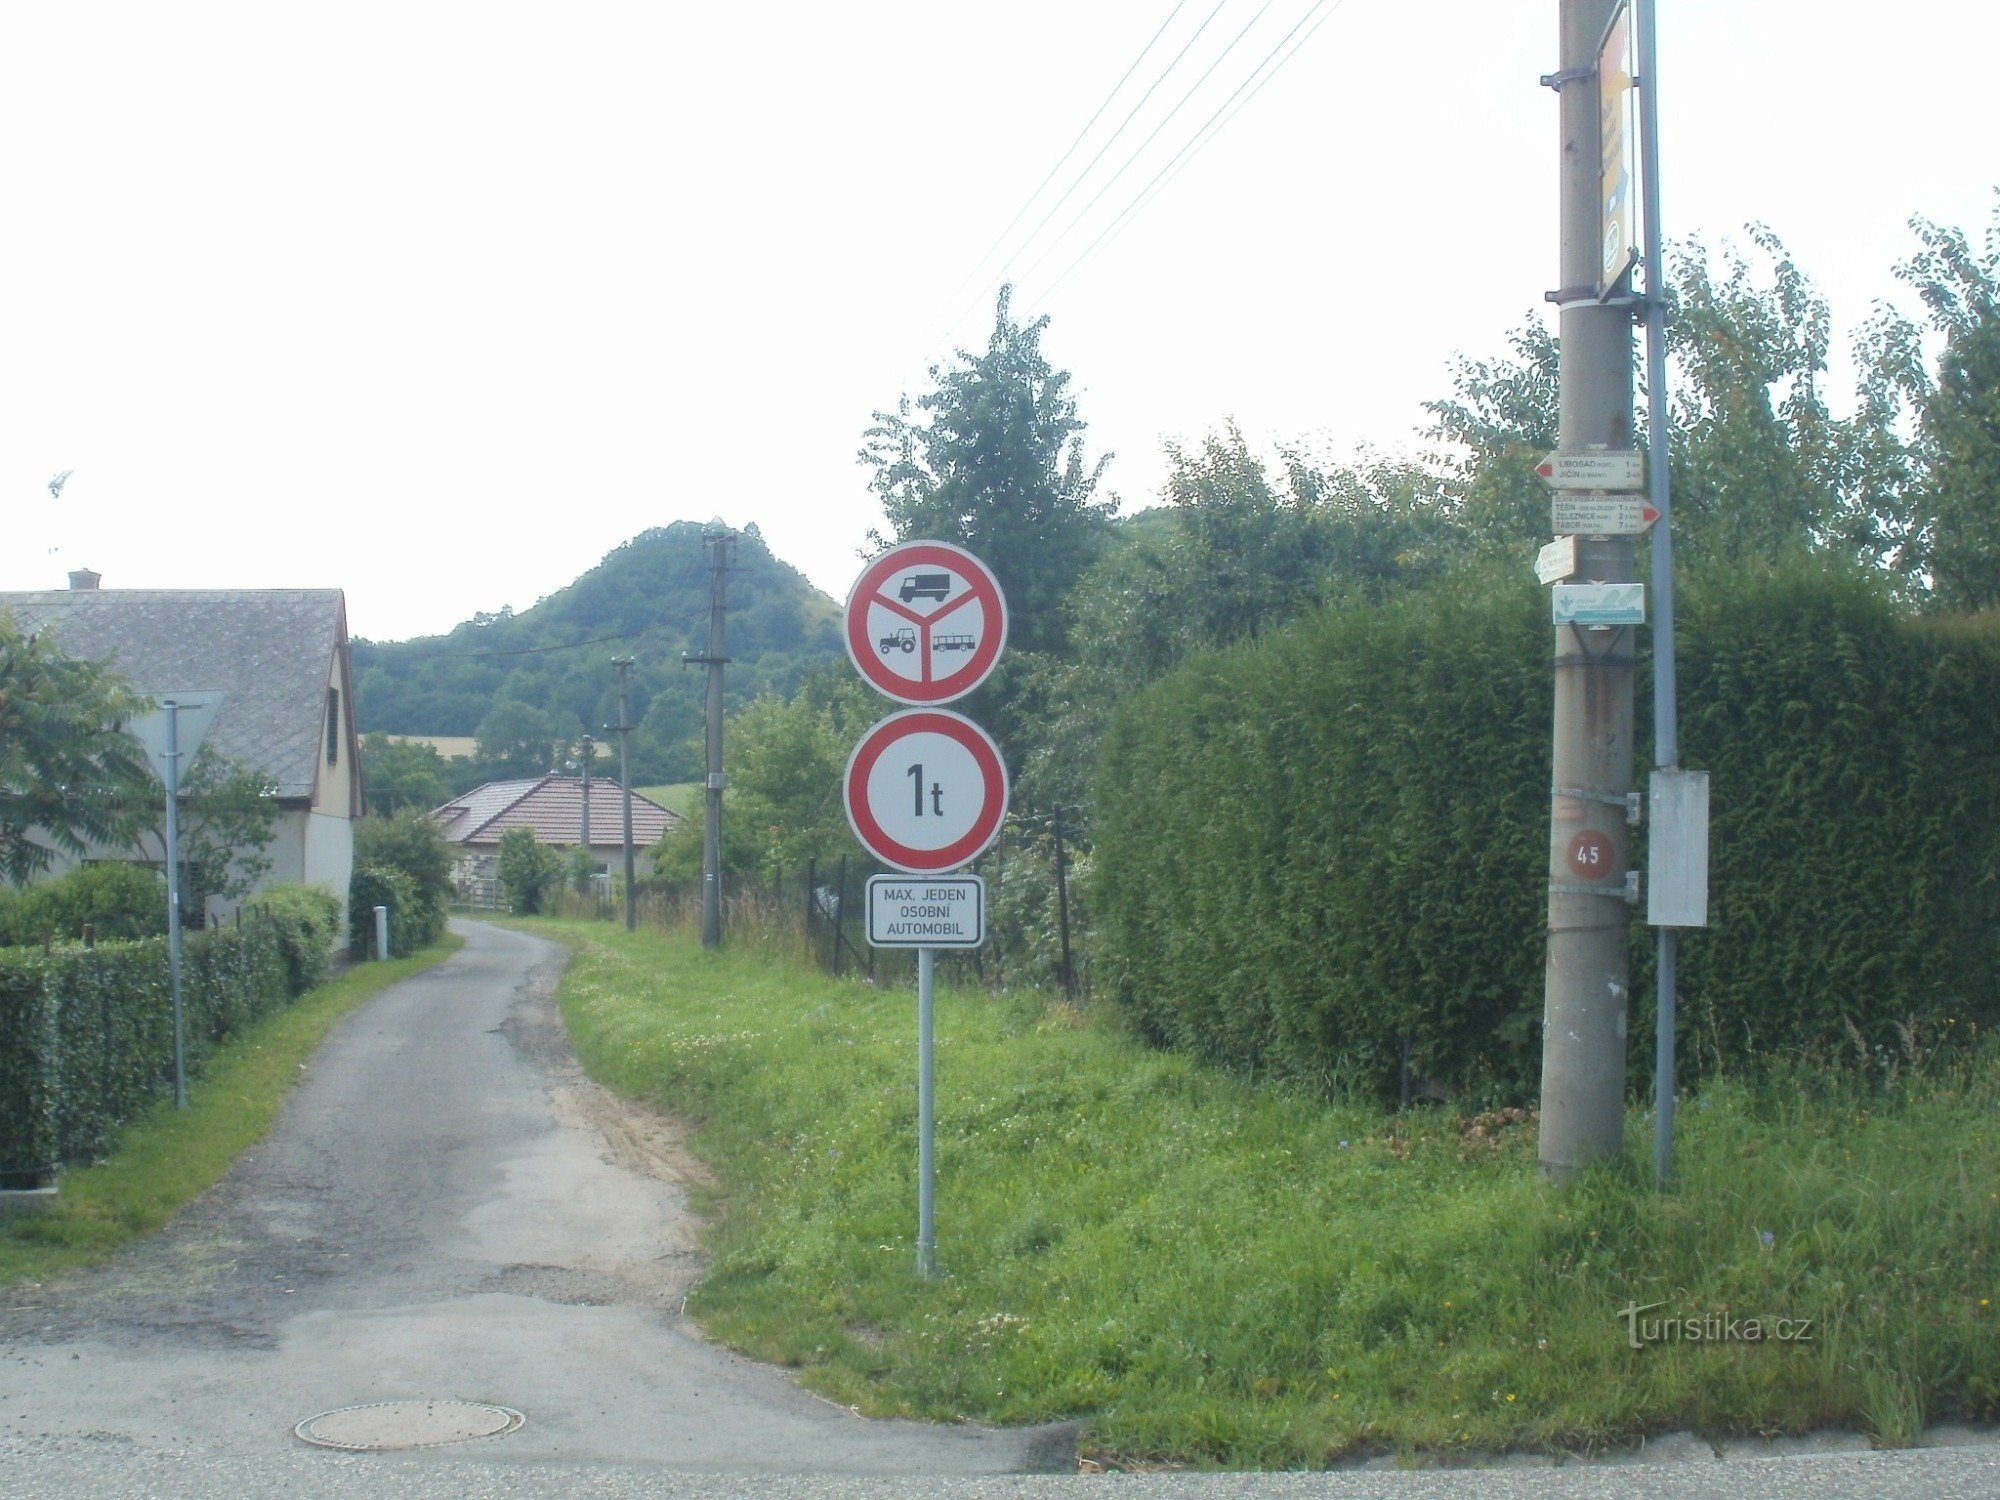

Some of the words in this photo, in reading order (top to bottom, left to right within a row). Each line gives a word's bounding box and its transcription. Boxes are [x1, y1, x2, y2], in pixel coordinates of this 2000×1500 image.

[1577, 846, 1599, 864] 45
[884, 889, 915, 901] MAX.
[922, 889, 966, 901] JEDEN
[900, 902, 950, 918] OSOBNÍ
[887, 922, 964, 935] AUTOMOBIL
